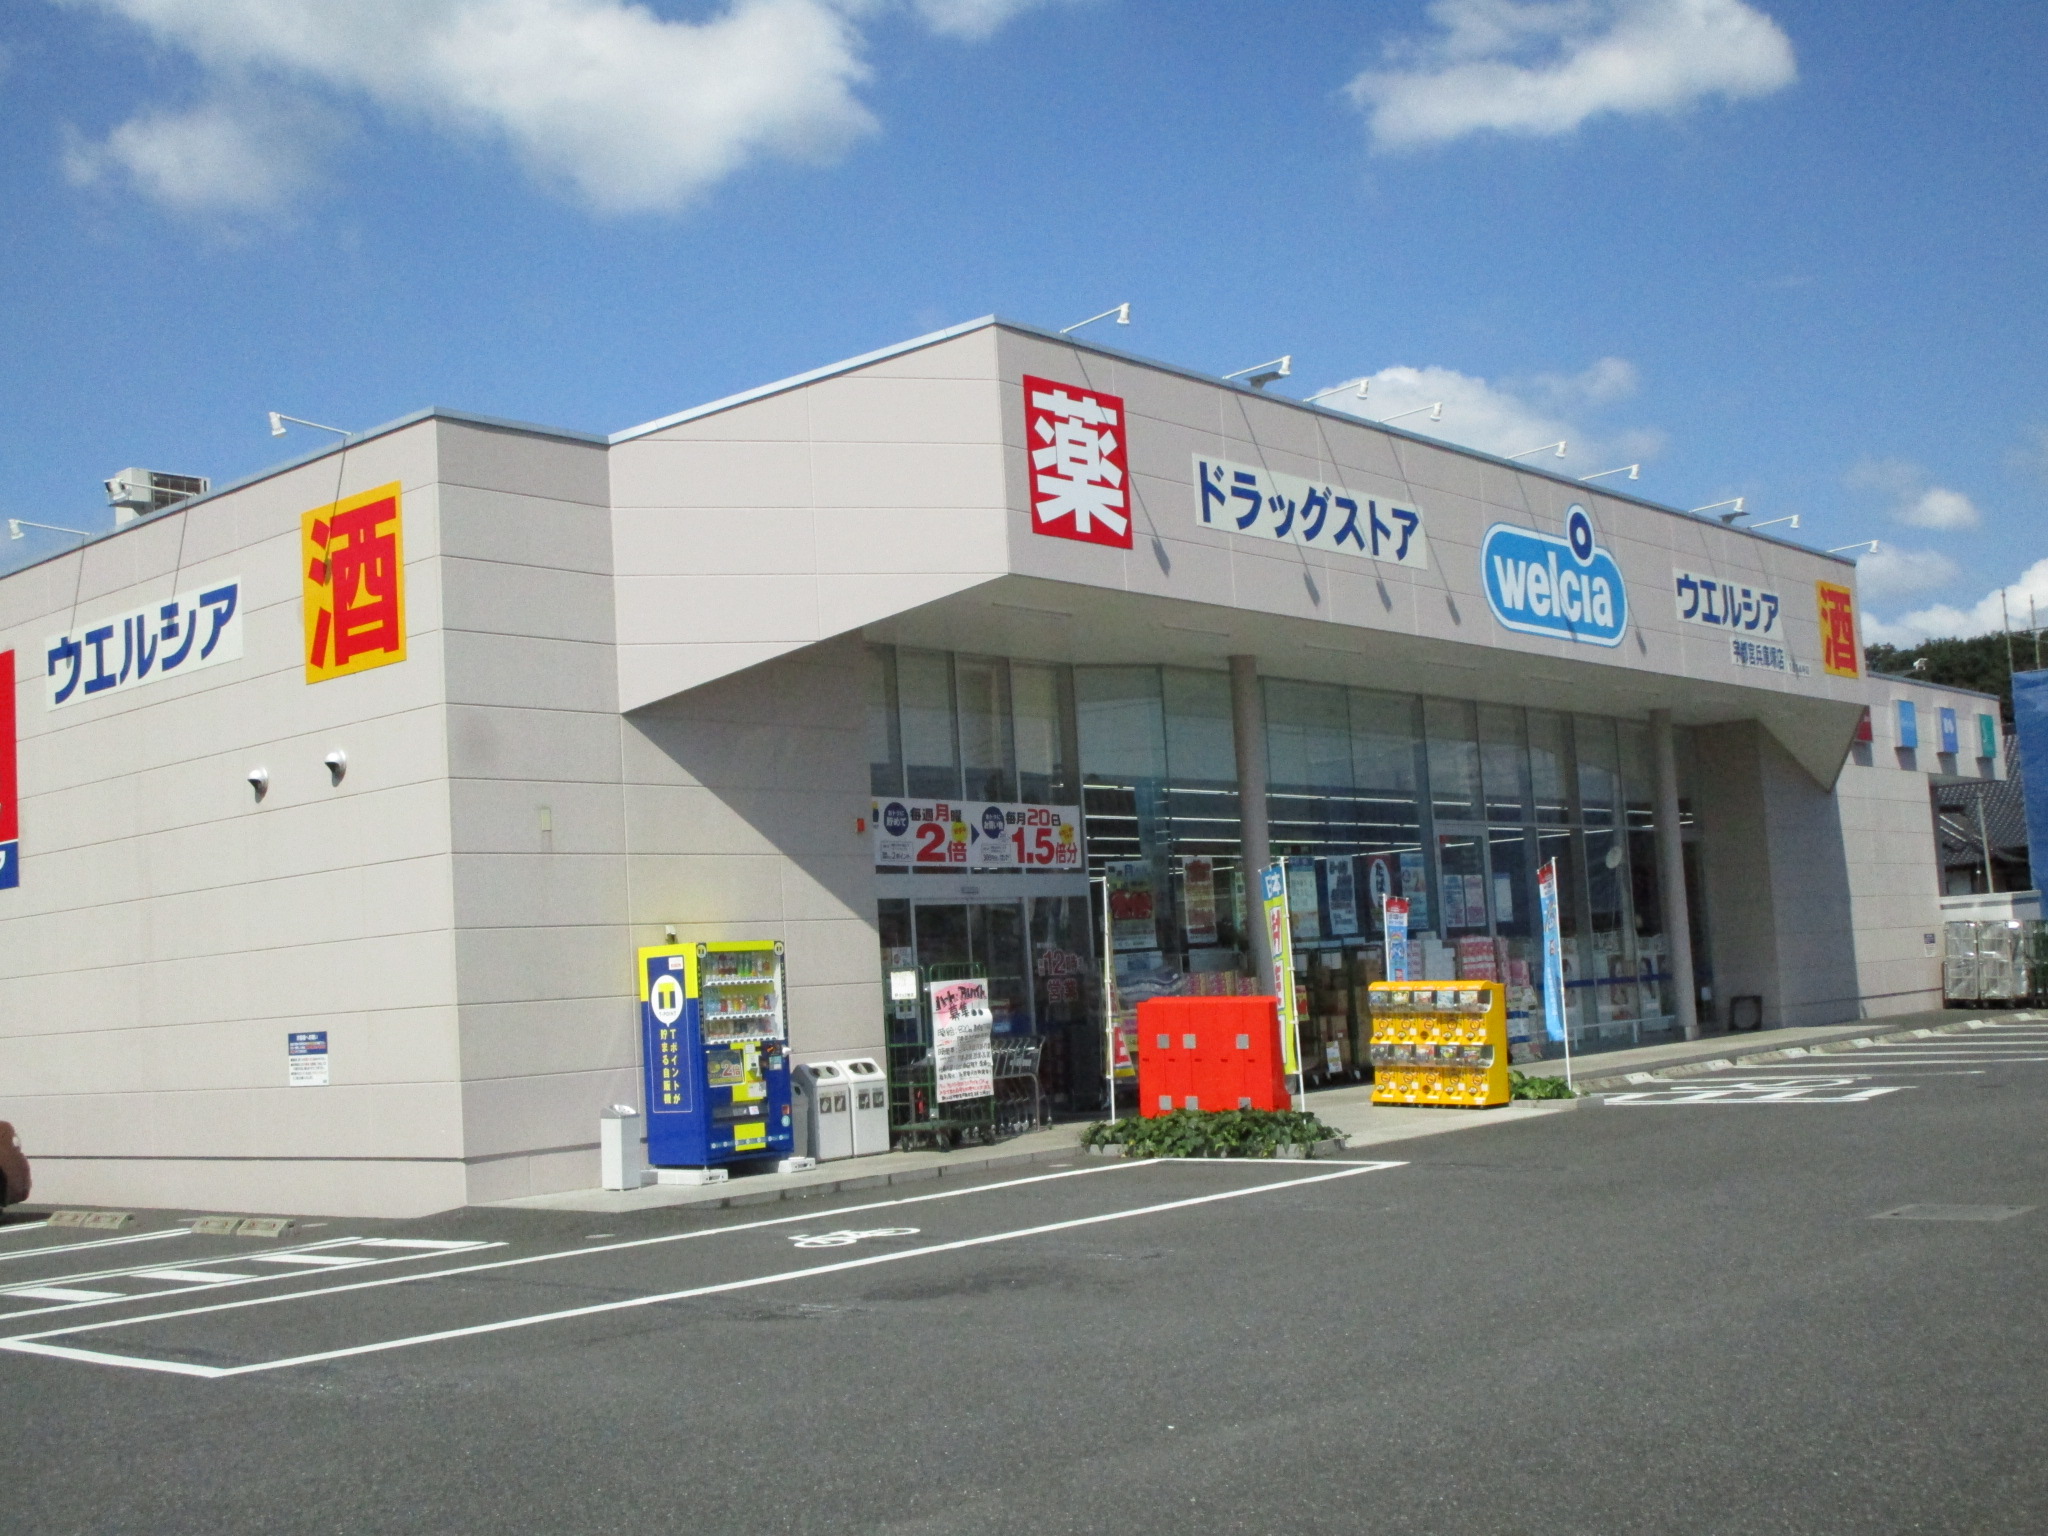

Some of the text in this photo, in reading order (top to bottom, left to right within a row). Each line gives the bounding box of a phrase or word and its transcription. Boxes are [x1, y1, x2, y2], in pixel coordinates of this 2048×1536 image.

[1032, 389, 1127, 536] 薬
[1200, 460, 1419, 561] ドラッグストア
[308, 496, 399, 669] 酒
[1494, 551, 1614, 628] welcia
[1677, 573, 1779, 633] ウエルシア
[1820, 586, 1857, 673] 酒
[48, 583, 239, 705] ウエルシア
[670, 1028, 680, 1104] Tポイントが
